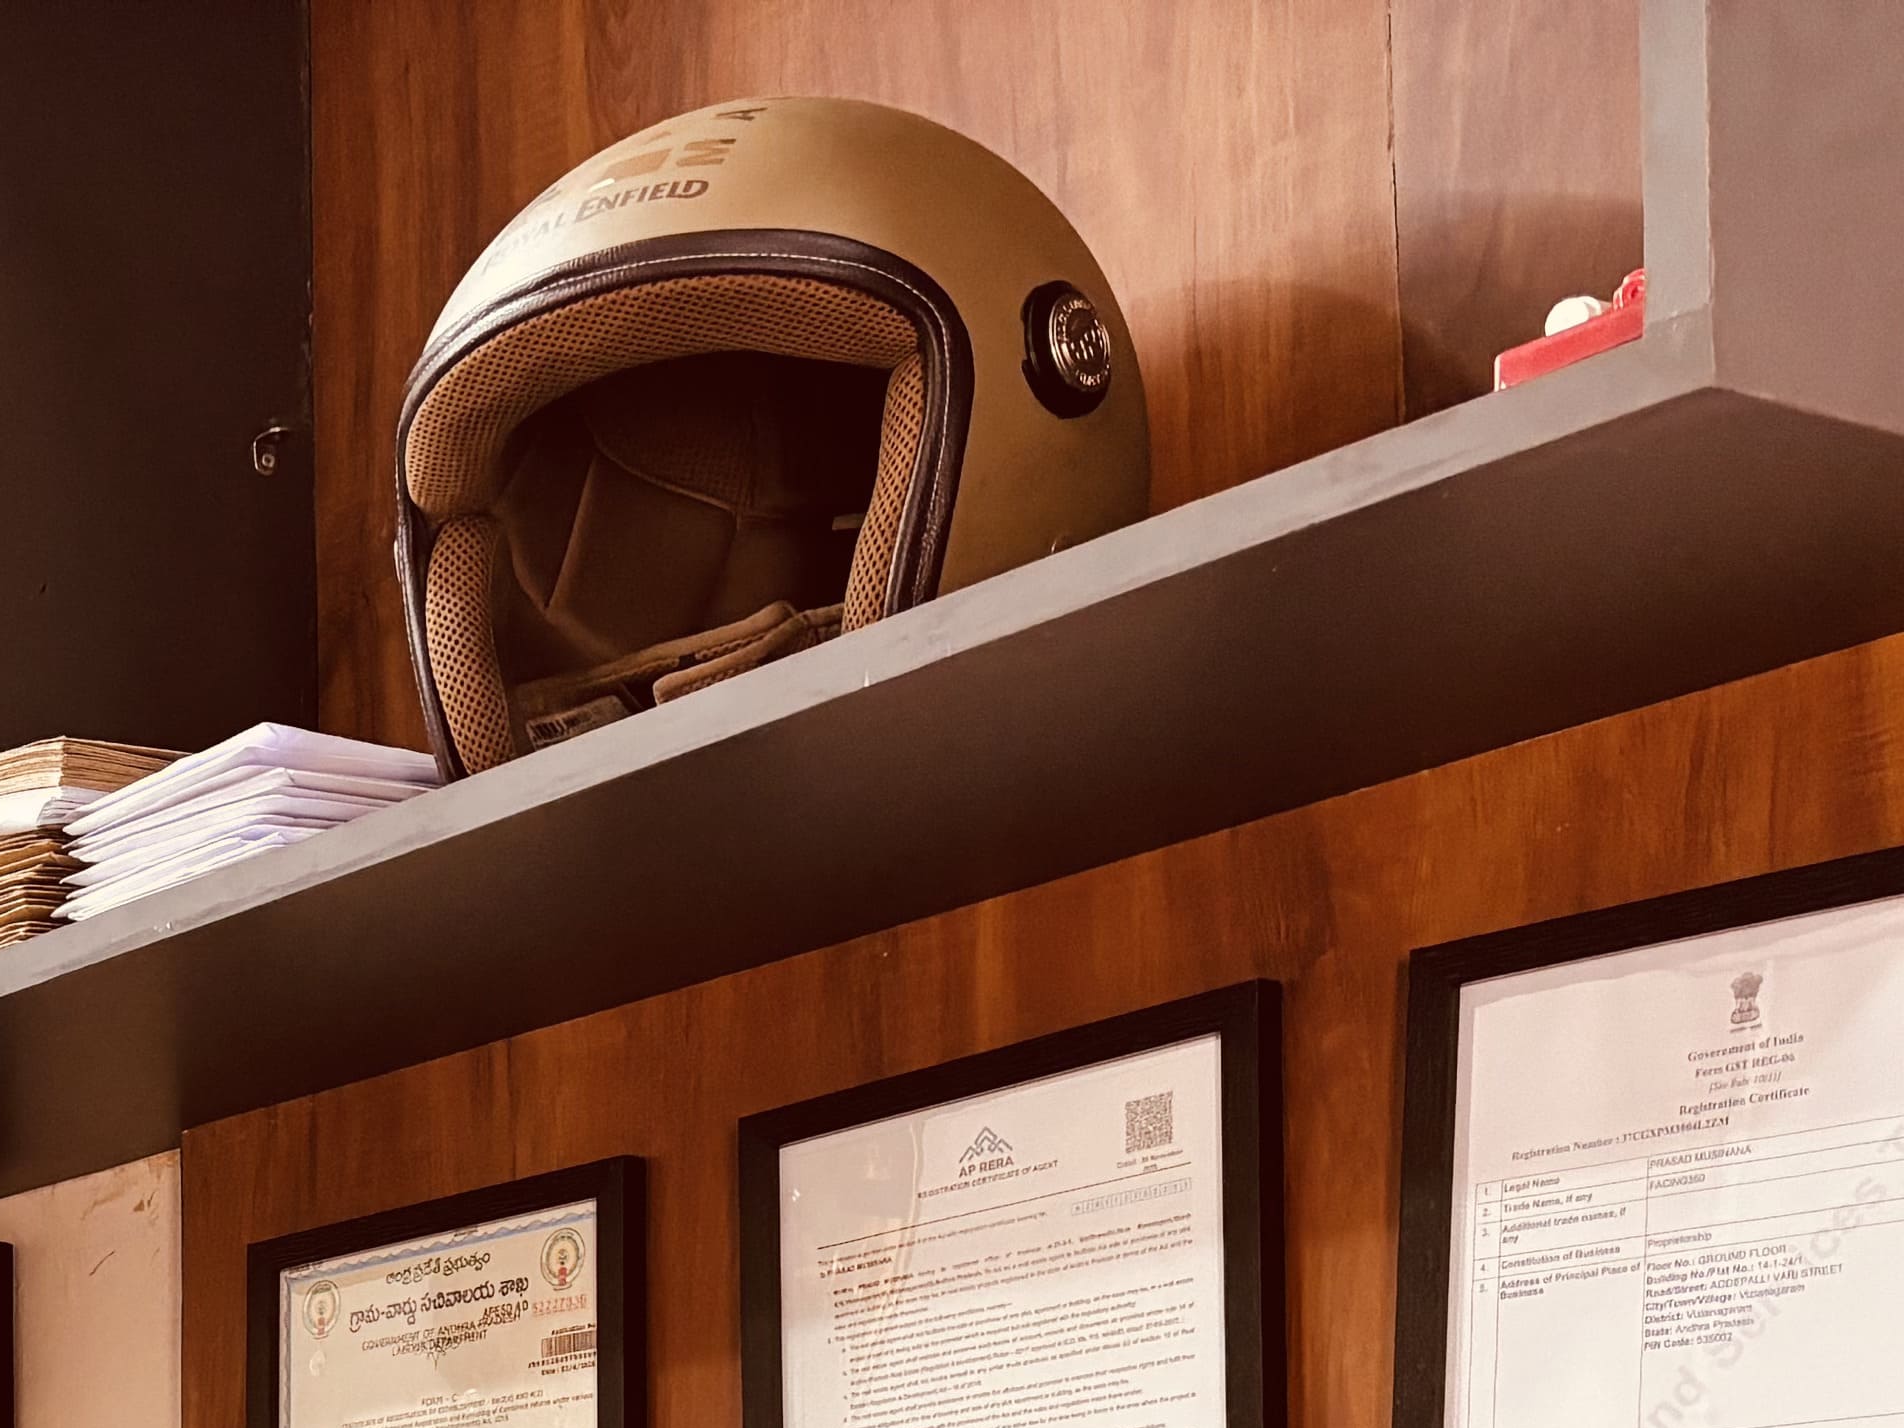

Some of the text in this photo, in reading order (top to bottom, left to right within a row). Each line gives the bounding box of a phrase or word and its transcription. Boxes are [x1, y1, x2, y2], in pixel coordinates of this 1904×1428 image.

[575, 180, 709, 224] ENFIELD
[959, 1156, 1014, 1178] AP RERA
